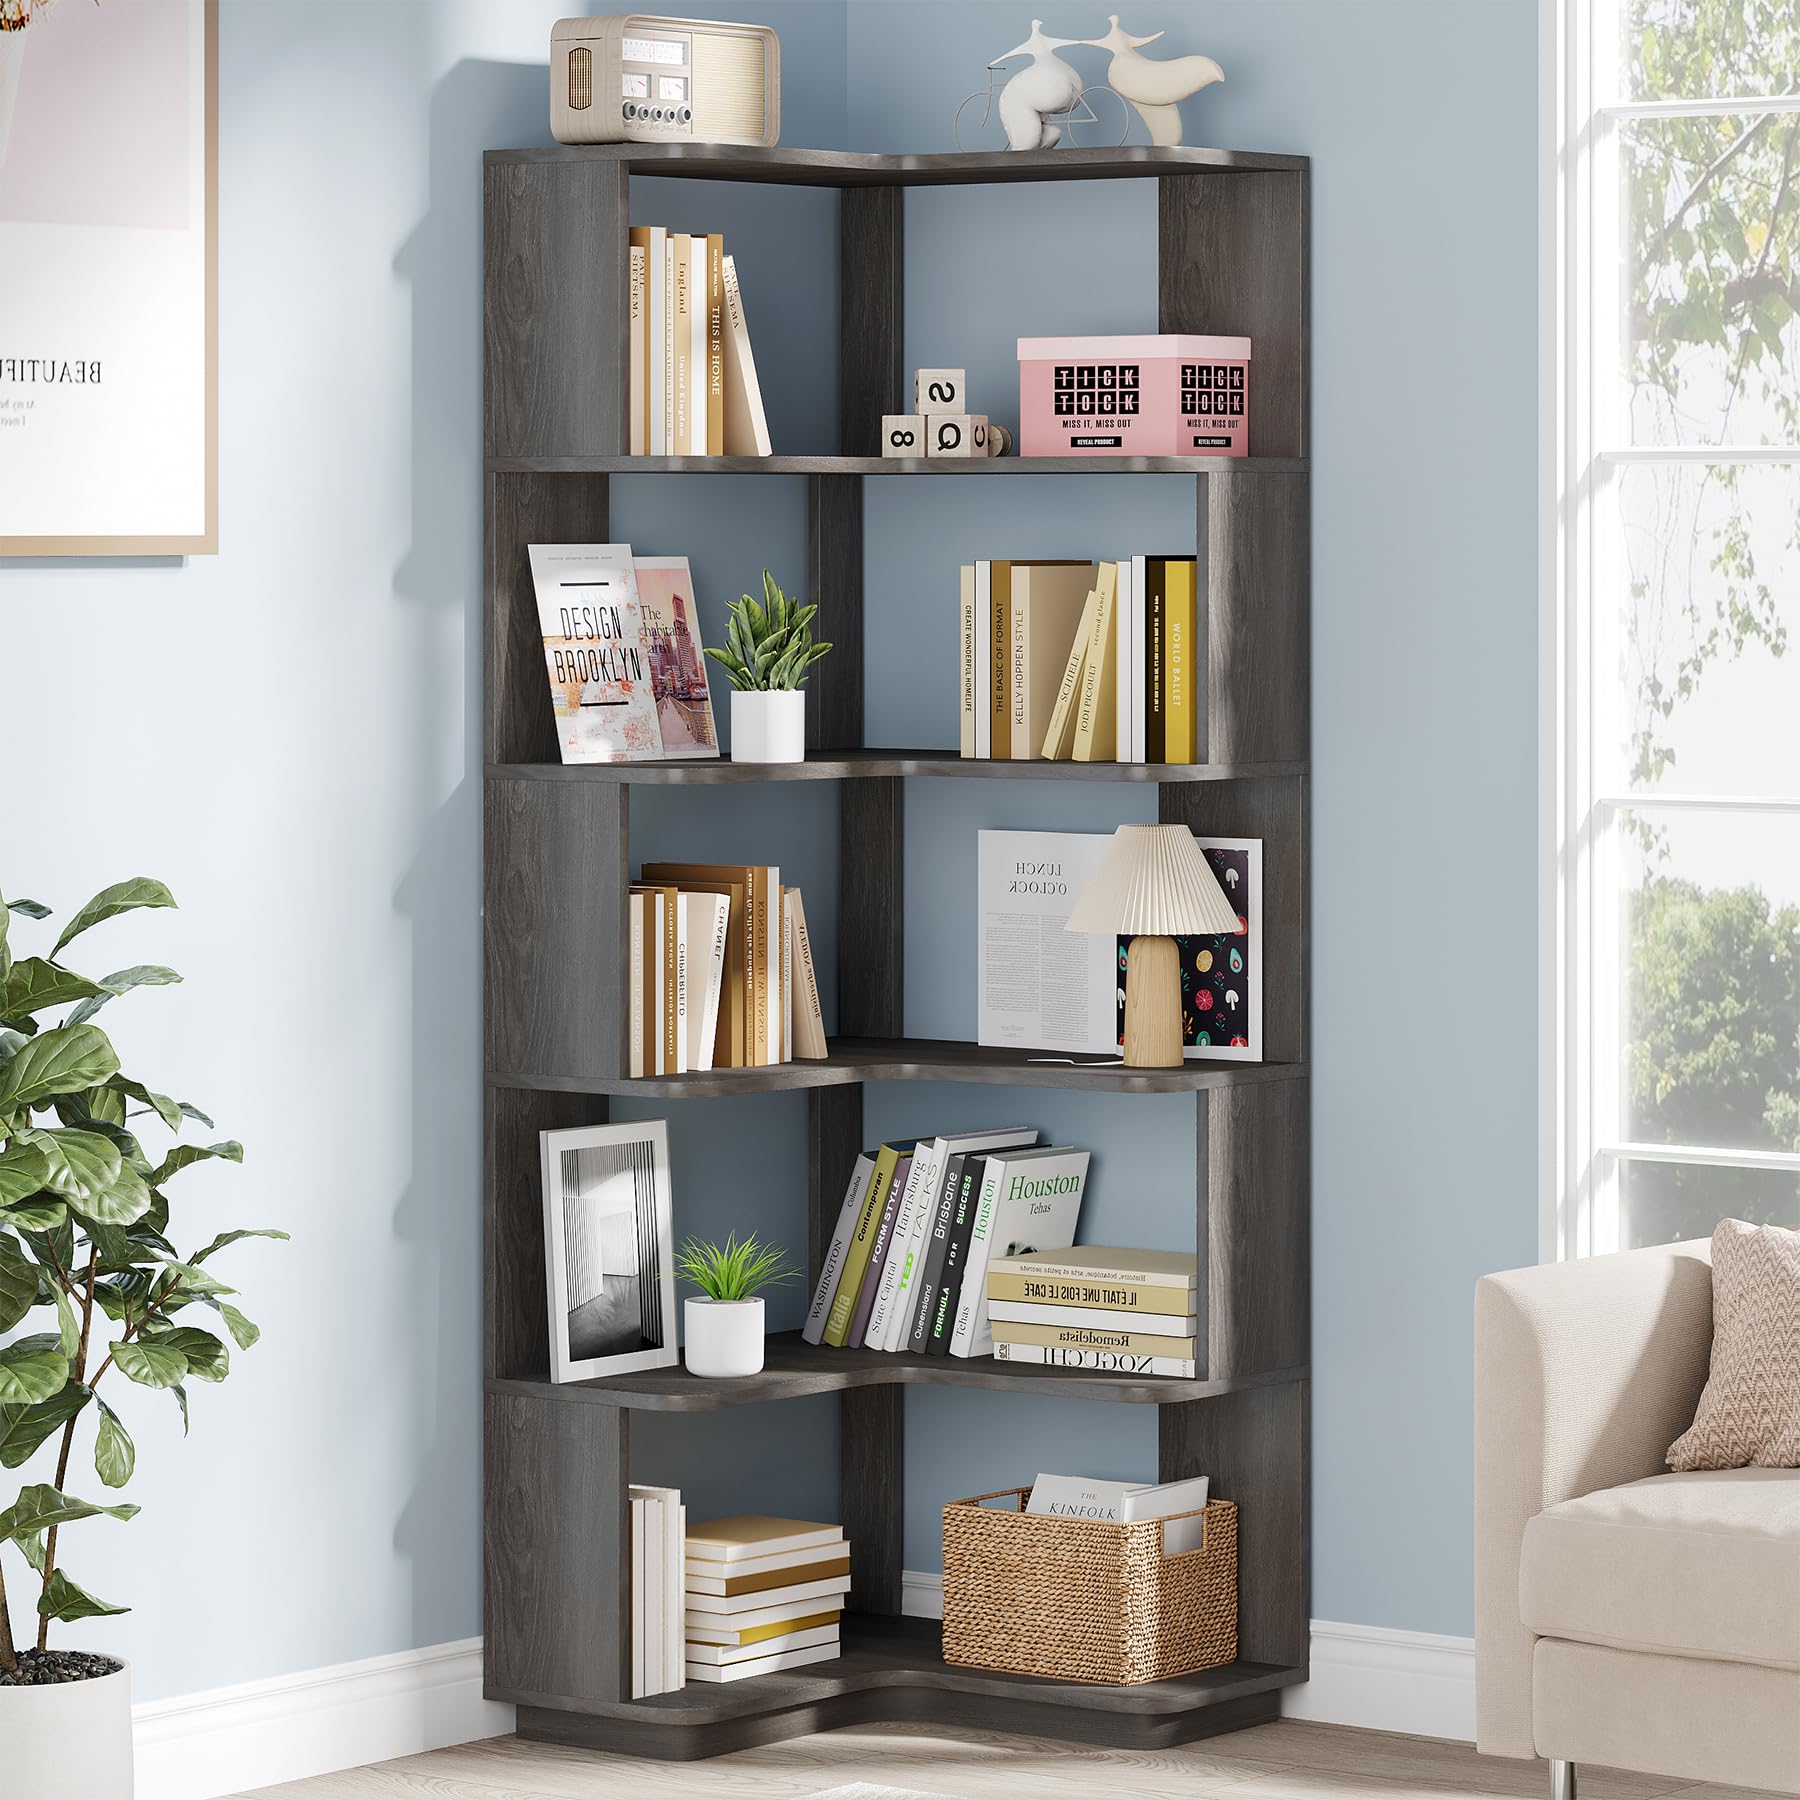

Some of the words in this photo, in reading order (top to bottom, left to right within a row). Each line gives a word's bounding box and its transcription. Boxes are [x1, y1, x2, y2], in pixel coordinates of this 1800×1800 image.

[679, 262, 687, 315] England
[723, 266, 739, 329] SIETSEMA
[730, 264, 739, 297] PAUL
[712, 305, 720, 337] THIS
[712, 340, 720, 351] IS
[712, 355, 720, 396] HOME
[1058, 369, 1136, 387] TICK
[1183, 368, 1242, 387] TICK
[678, 390, 686, 437] Kingdom
[1058, 393, 1136, 412] TOCK
[1183, 393, 1242, 412] TOCK
[890, 430, 915, 447] 8
[1062, 419, 1081, 429] MISS
[1084, 419, 1093, 429] IT,
[1096, 419, 1115, 428] MISS
[1117, 419, 1131, 428] OUT
[1187, 419, 1201, 428] MISS
[1212, 419, 1226, 428] MISS
[1228, 419, 1238, 429] OUT
[560, 605, 623, 641] DESIGN
[639, 605, 661, 621] The
[996, 602, 1004, 643] FORMAT
[1015, 609, 1024, 641] STYLE
[1093, 617, 1103, 646] second
[1099, 591, 1107, 617] glance
[646, 638, 671, 654] arth
[996, 646, 1004, 659] OF
[1172, 623, 1181, 666] WORLD
[554, 648, 642, 684] BROOKLYN
[996, 663, 1004, 693] BASIC
[1015, 645, 1024, 687] HOPPEN
[1061, 654, 1080, 703] SCHIELE
[1084, 664, 1097, 706] PICOULT
[1172, 668, 1181, 707] BALLET
[996, 694, 1004, 713] THE
[1015, 690, 1024, 725] KELLY
[1080, 706, 1094, 733] JODI
[847, 1175, 862, 1208] Columbia
[895, 1161, 925, 1239] Harrisburg
[1008, 1171, 1080, 1202] Houston
[857, 1171, 884, 1242] Contemporan
[871, 1222, 889, 1264] FORM
[882, 1178, 901, 1221] STYLE
[974, 1179, 996, 1242] Houston
[1029, 1202, 1052, 1216] Tehas
[898, 1252, 914, 1290] TED
[912, 1163, 938, 1239] TALKS
[933, 1287, 951, 1338] FORMULA
[948, 1242, 959, 1266] FOR
[956, 1175, 972, 1225] SUCCESS
[812, 1239, 843, 1320] WASHINGTON
[871, 1301, 886, 1334] State
[880, 1260, 898, 1303] Capital
[827, 1295, 851, 1335] Italia
[914, 1284, 932, 1340] Queensland
[955, 1305, 970, 1338] Tehas
[1049, 1502, 1116, 1520] KINFOLK
[1081, 1492, 1097, 1500] THE
